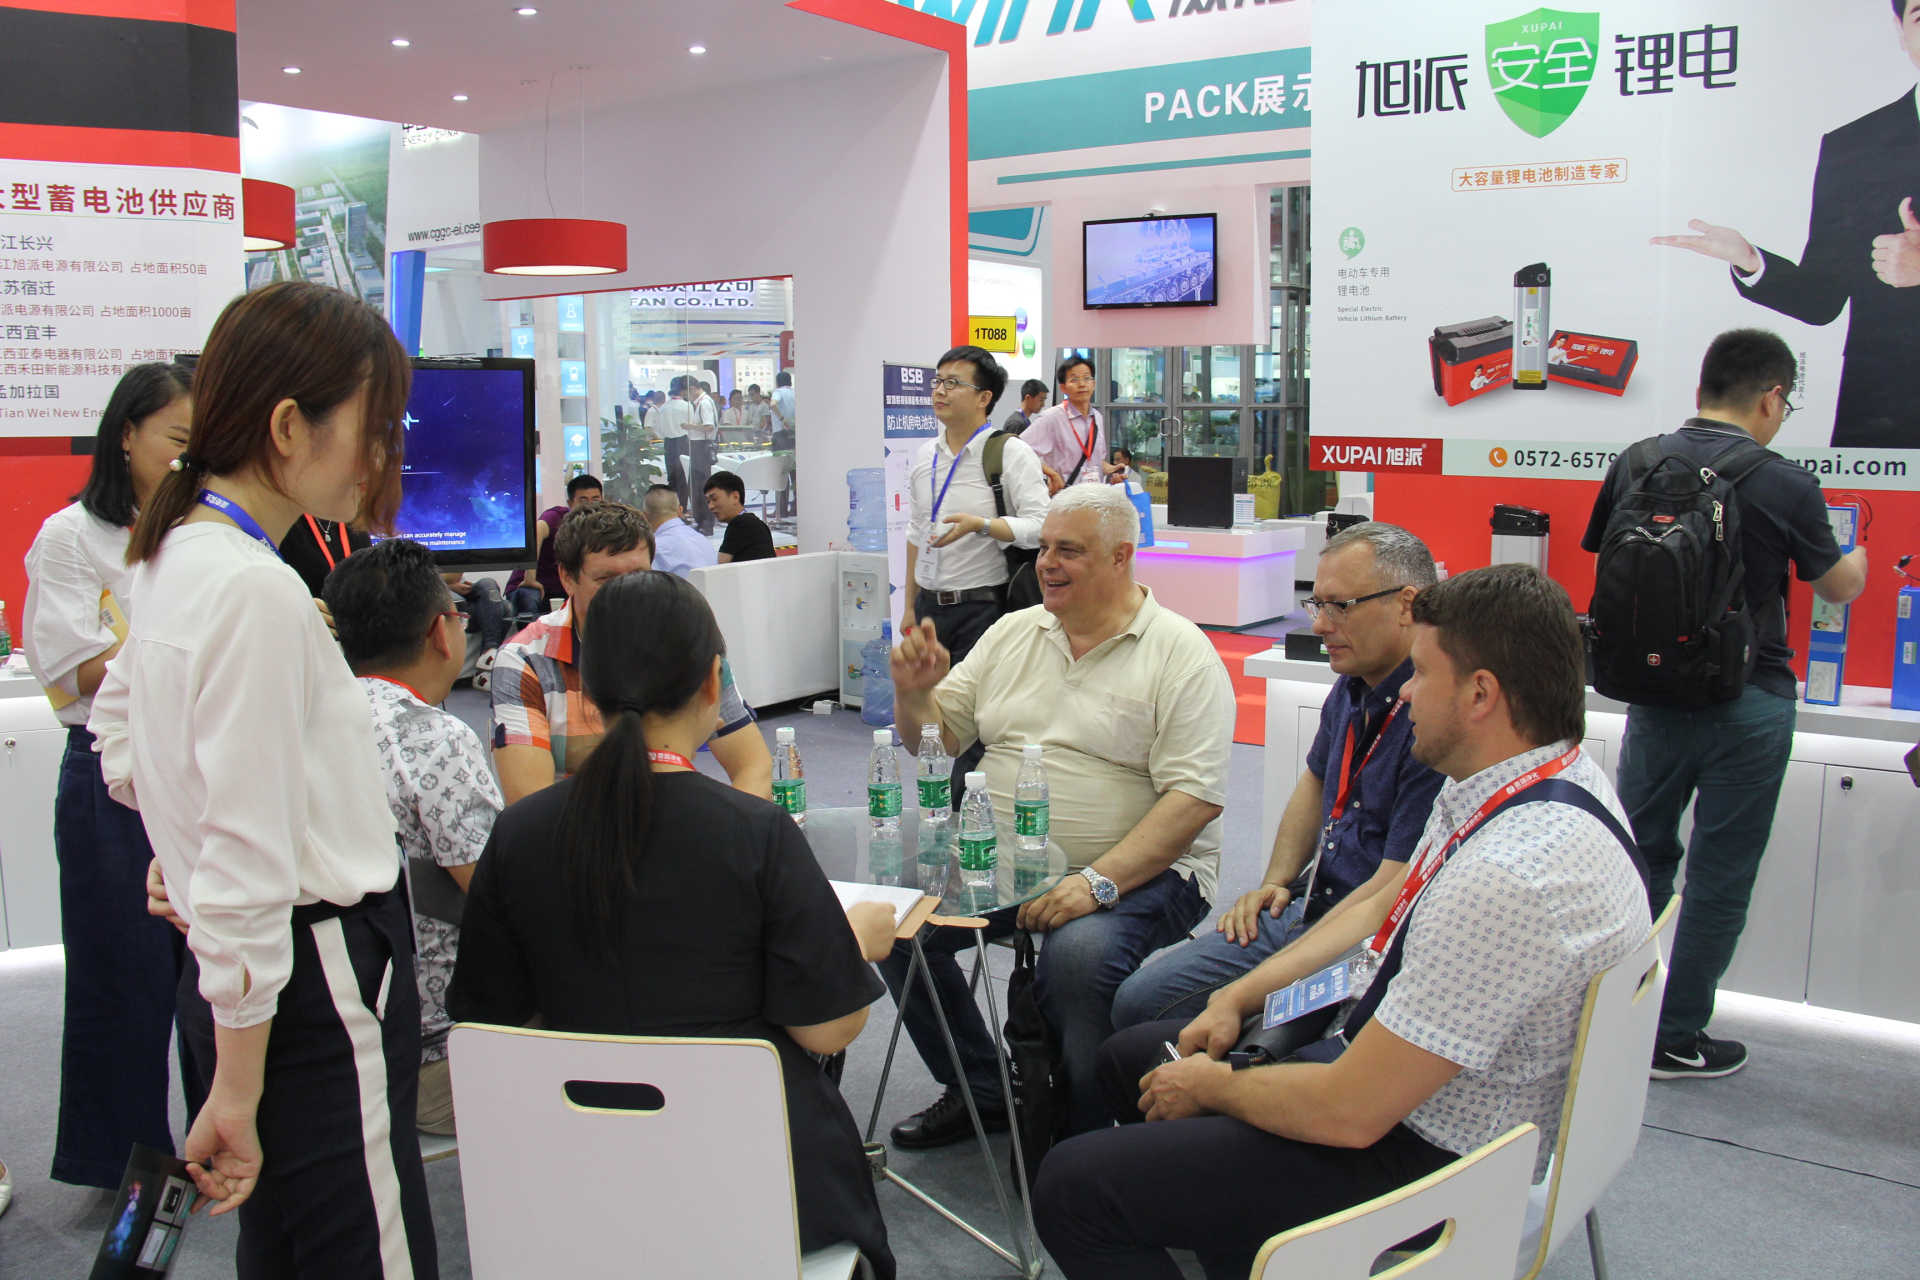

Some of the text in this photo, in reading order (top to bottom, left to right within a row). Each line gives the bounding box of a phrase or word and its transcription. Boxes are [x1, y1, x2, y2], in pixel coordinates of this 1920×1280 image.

[1521, 21, 1563, 34] XUPAI
[1356, 24, 1739, 119] 旭派 安全 锂电
[1458, 162, 1621, 188] 大容量锂电池制造专家
[0, 183, 235, 220] 型蓄电池供应商
[130, 263, 207, 276] 占地面积50亩
[1337, 266, 1390, 279] 电动车专用
[0, 280, 56, 296] 苏宿迁
[1337, 284, 1370, 296] 锂电池
[101, 304, 192, 319] 占地面积1000亩
[975, 327, 1007, 341] 1T088
[0, 348, 122, 361] 西亚泰电器有限公司
[901, 367, 924, 384] BSB
[27, 407, 50, 418] Wei
[53, 407, 80, 418] New
[1321, 445, 1423, 467] XUPAI 旭派
[1797, 454, 1906, 477] pai.com
